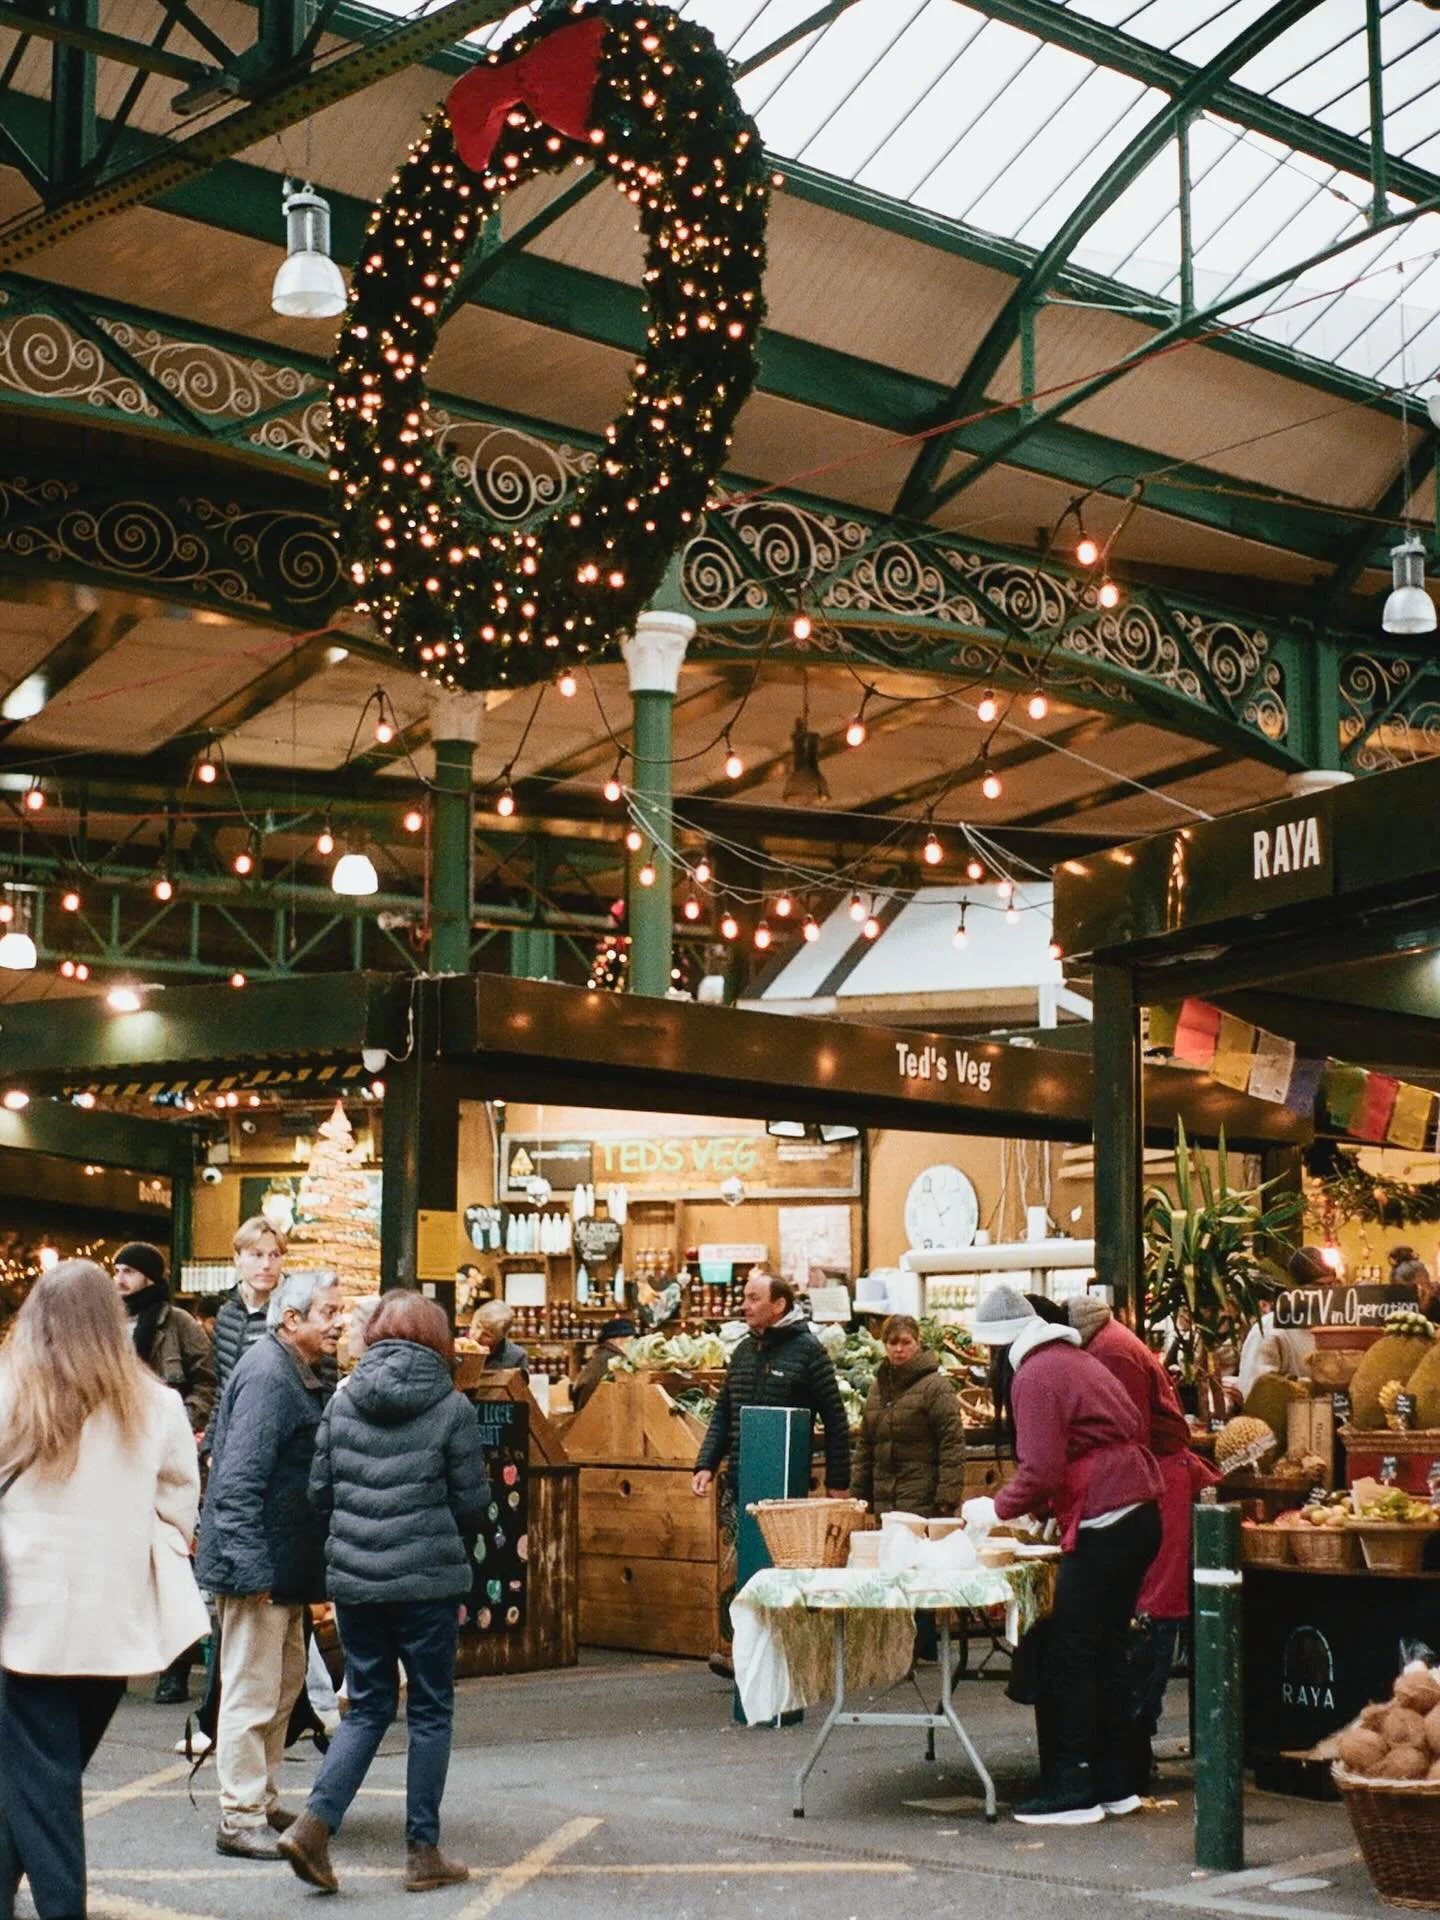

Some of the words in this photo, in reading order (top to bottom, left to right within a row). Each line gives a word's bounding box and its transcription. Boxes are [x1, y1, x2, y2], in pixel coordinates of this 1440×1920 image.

[1253, 817, 1321, 880] RAYA
[895, 1042, 948, 1081] Ted's
[955, 1050, 992, 1092] Veg
[691, 1136, 757, 1174] VEG
[1276, 1289, 1334, 1326] CCTV
[1331, 1310, 1344, 1325] in
[1345, 1287, 1419, 1327] Operation
[1282, 1683, 1335, 1710] RAYA
